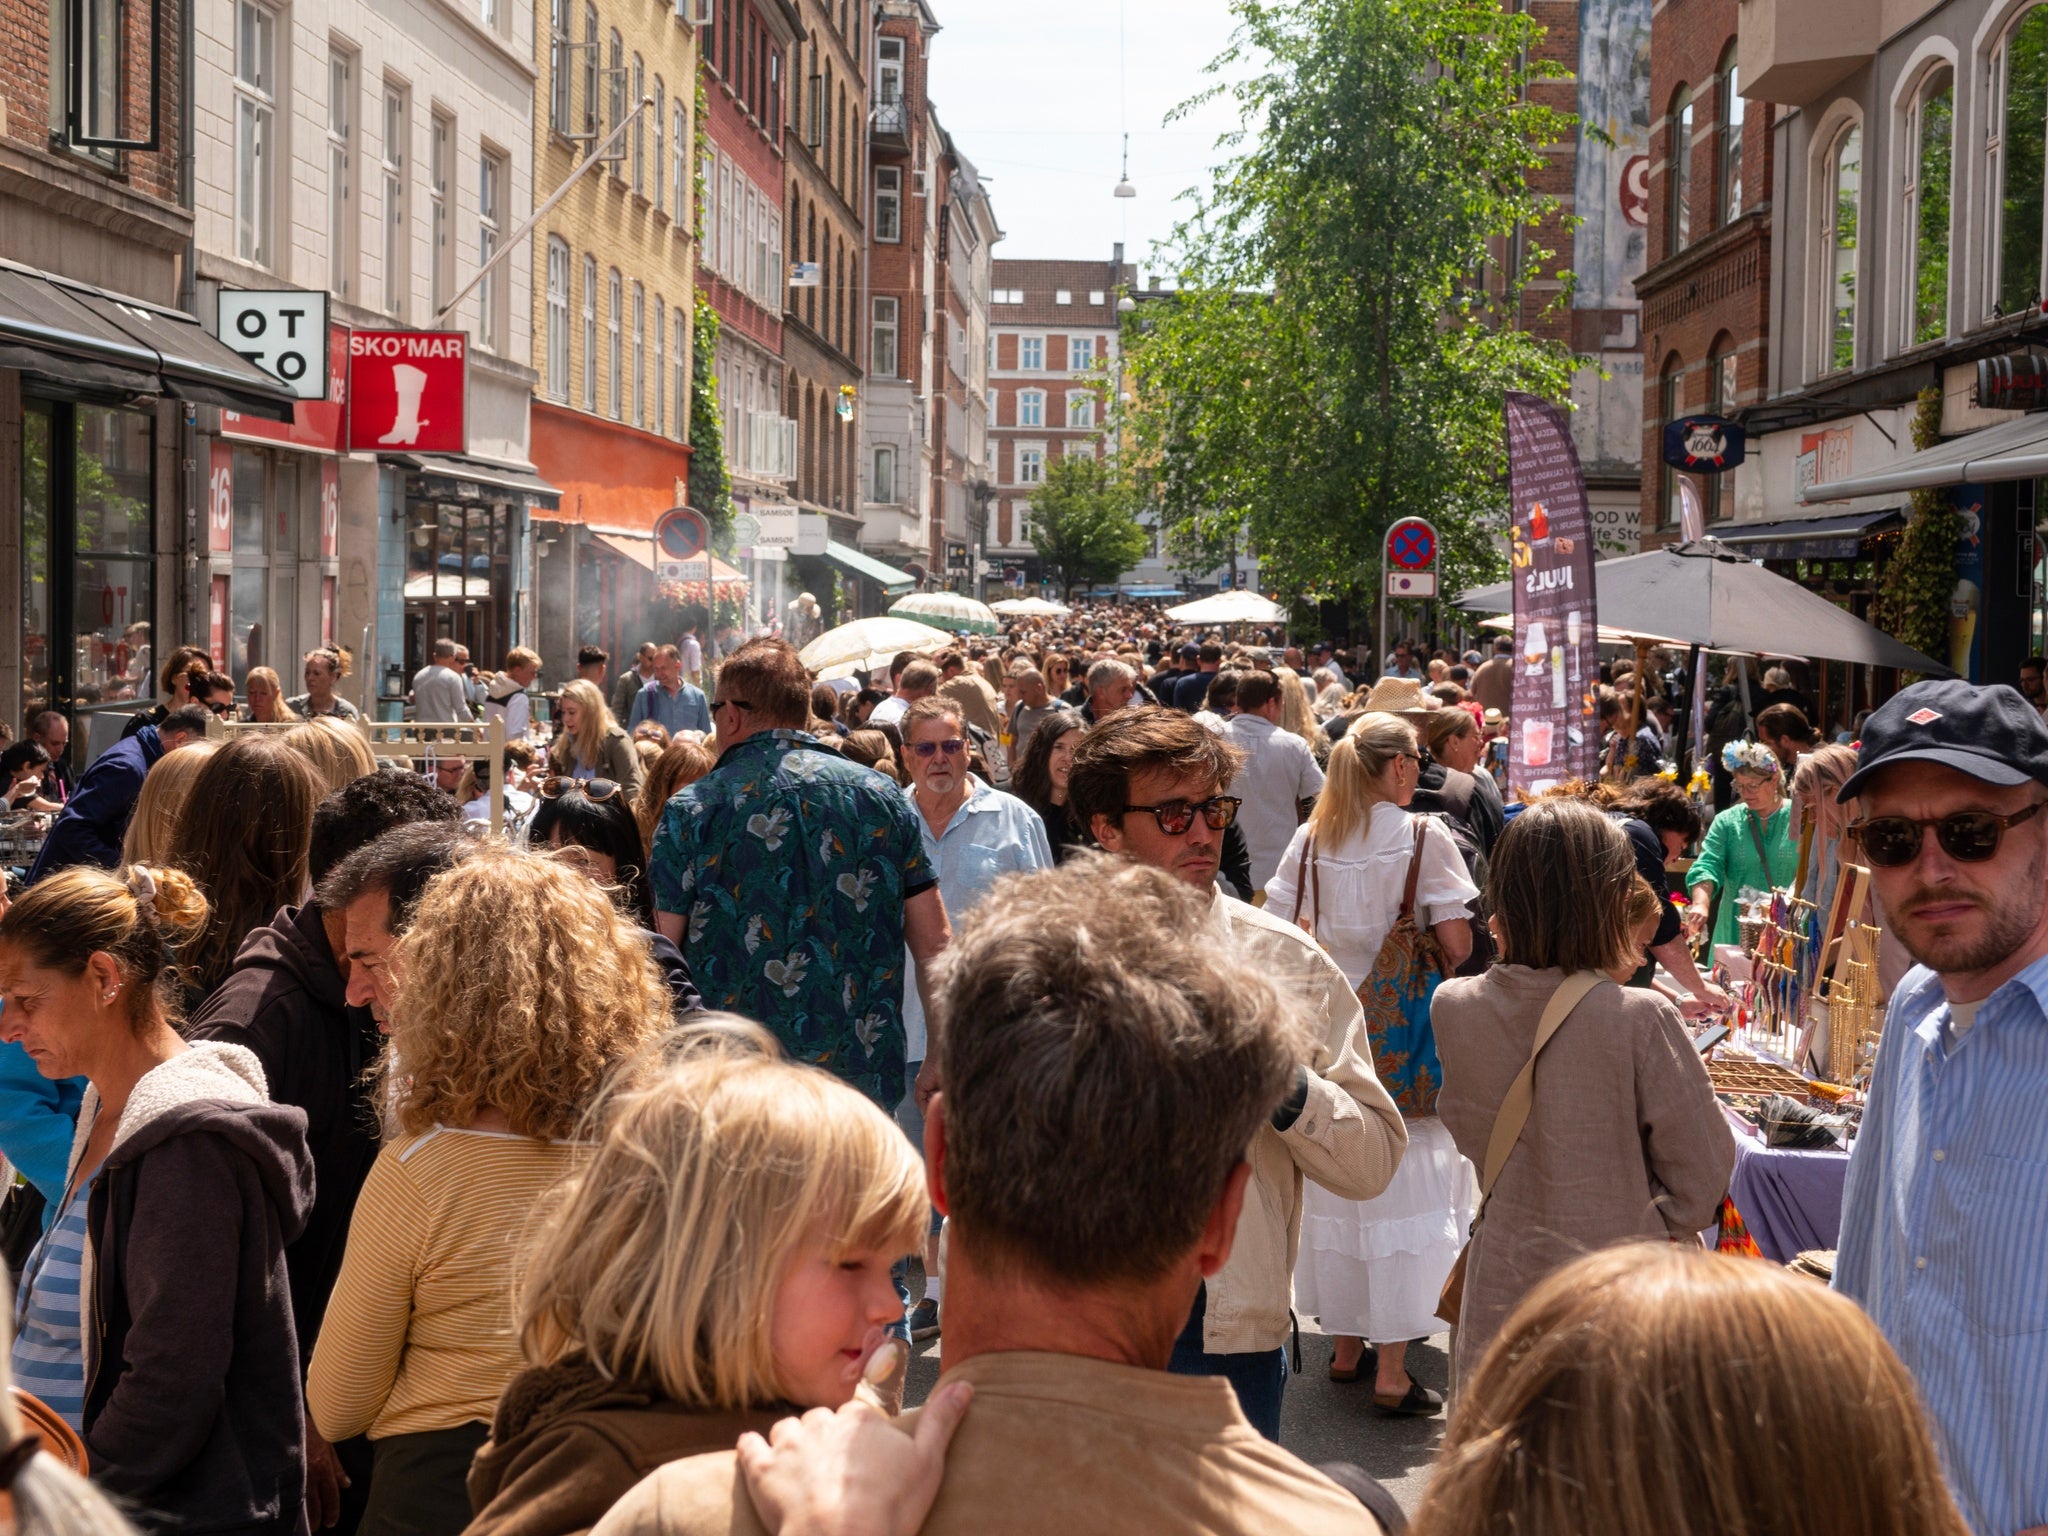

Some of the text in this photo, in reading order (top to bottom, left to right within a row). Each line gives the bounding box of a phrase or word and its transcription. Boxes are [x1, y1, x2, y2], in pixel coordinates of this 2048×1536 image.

[351, 337, 462, 358] SKO'MAR
[1691, 439, 1720, 453] 1664
[210, 467, 231, 530] 16
[322, 482, 338, 538] 16
